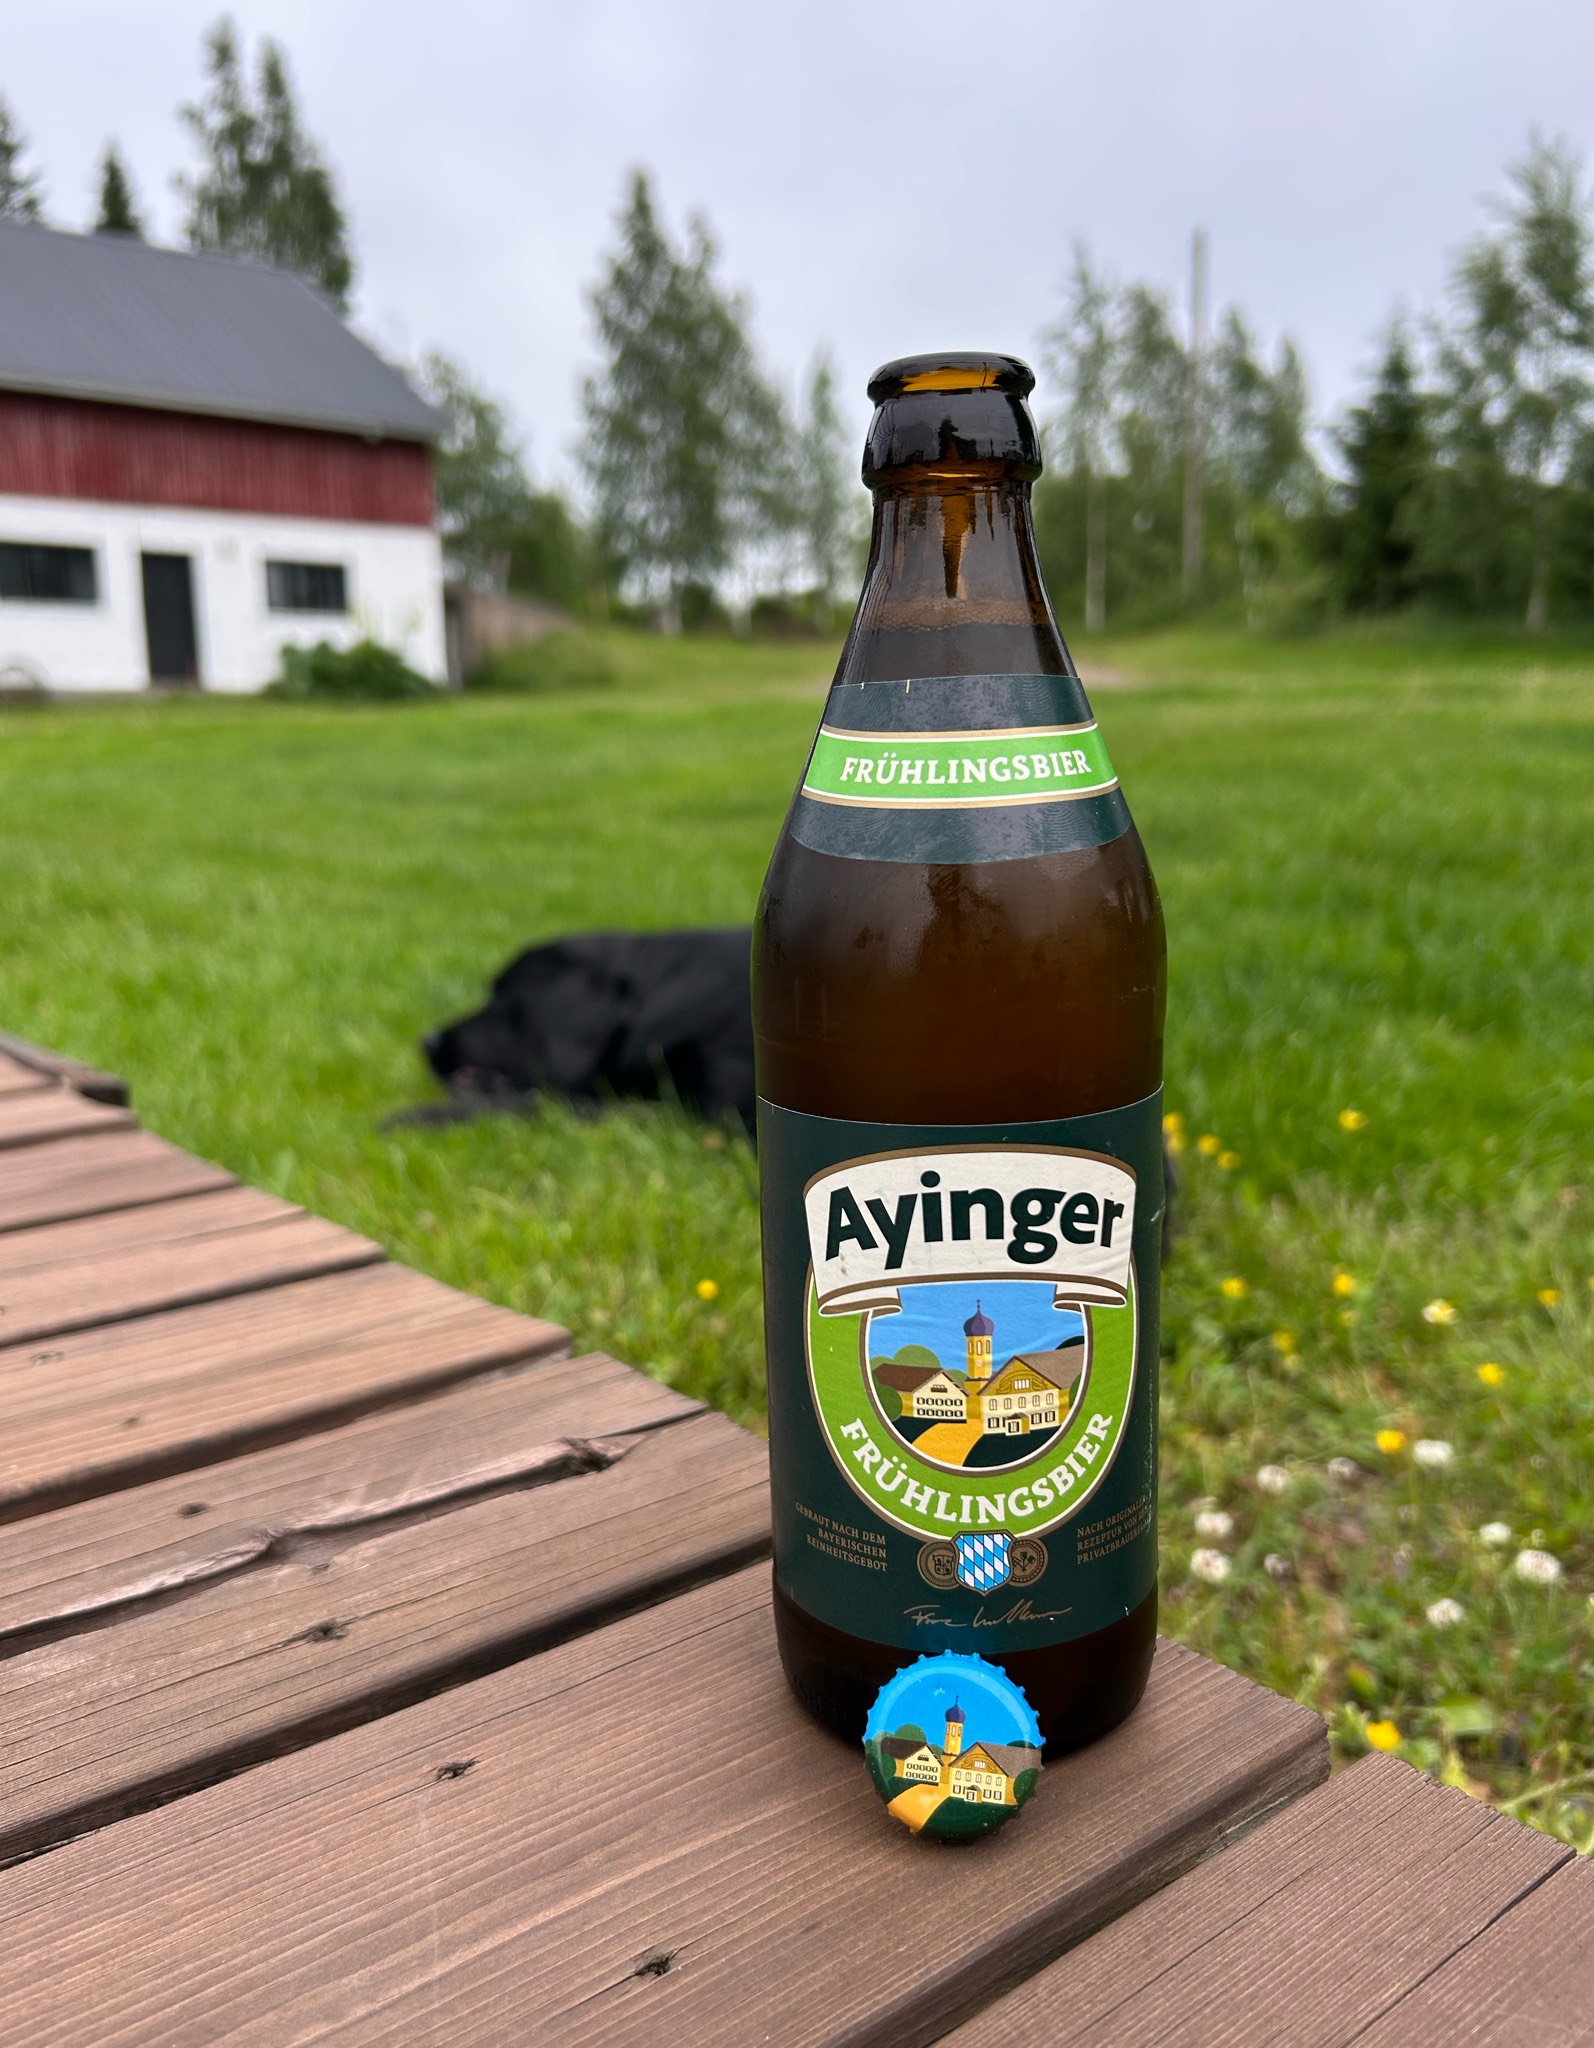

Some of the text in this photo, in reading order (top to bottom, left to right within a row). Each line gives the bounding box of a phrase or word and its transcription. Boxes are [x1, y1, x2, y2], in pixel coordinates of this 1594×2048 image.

[840, 750, 1092, 785] FRÜHLINGSBIER
[825, 1170, 1125, 1270] Ayinger
[839, 1412, 1113, 1524] FRÜHLINGSBIER
[795, 1502, 886, 1545] GEBRAUT NACH DEM
[1076, 1521, 1104, 1538] NACH
[1076, 1525, 1122, 1551] REZEPTUR
[806, 1534, 888, 1572] REINHEITSGEBOT
[818, 1527, 887, 1558] BAYERISCHEN
